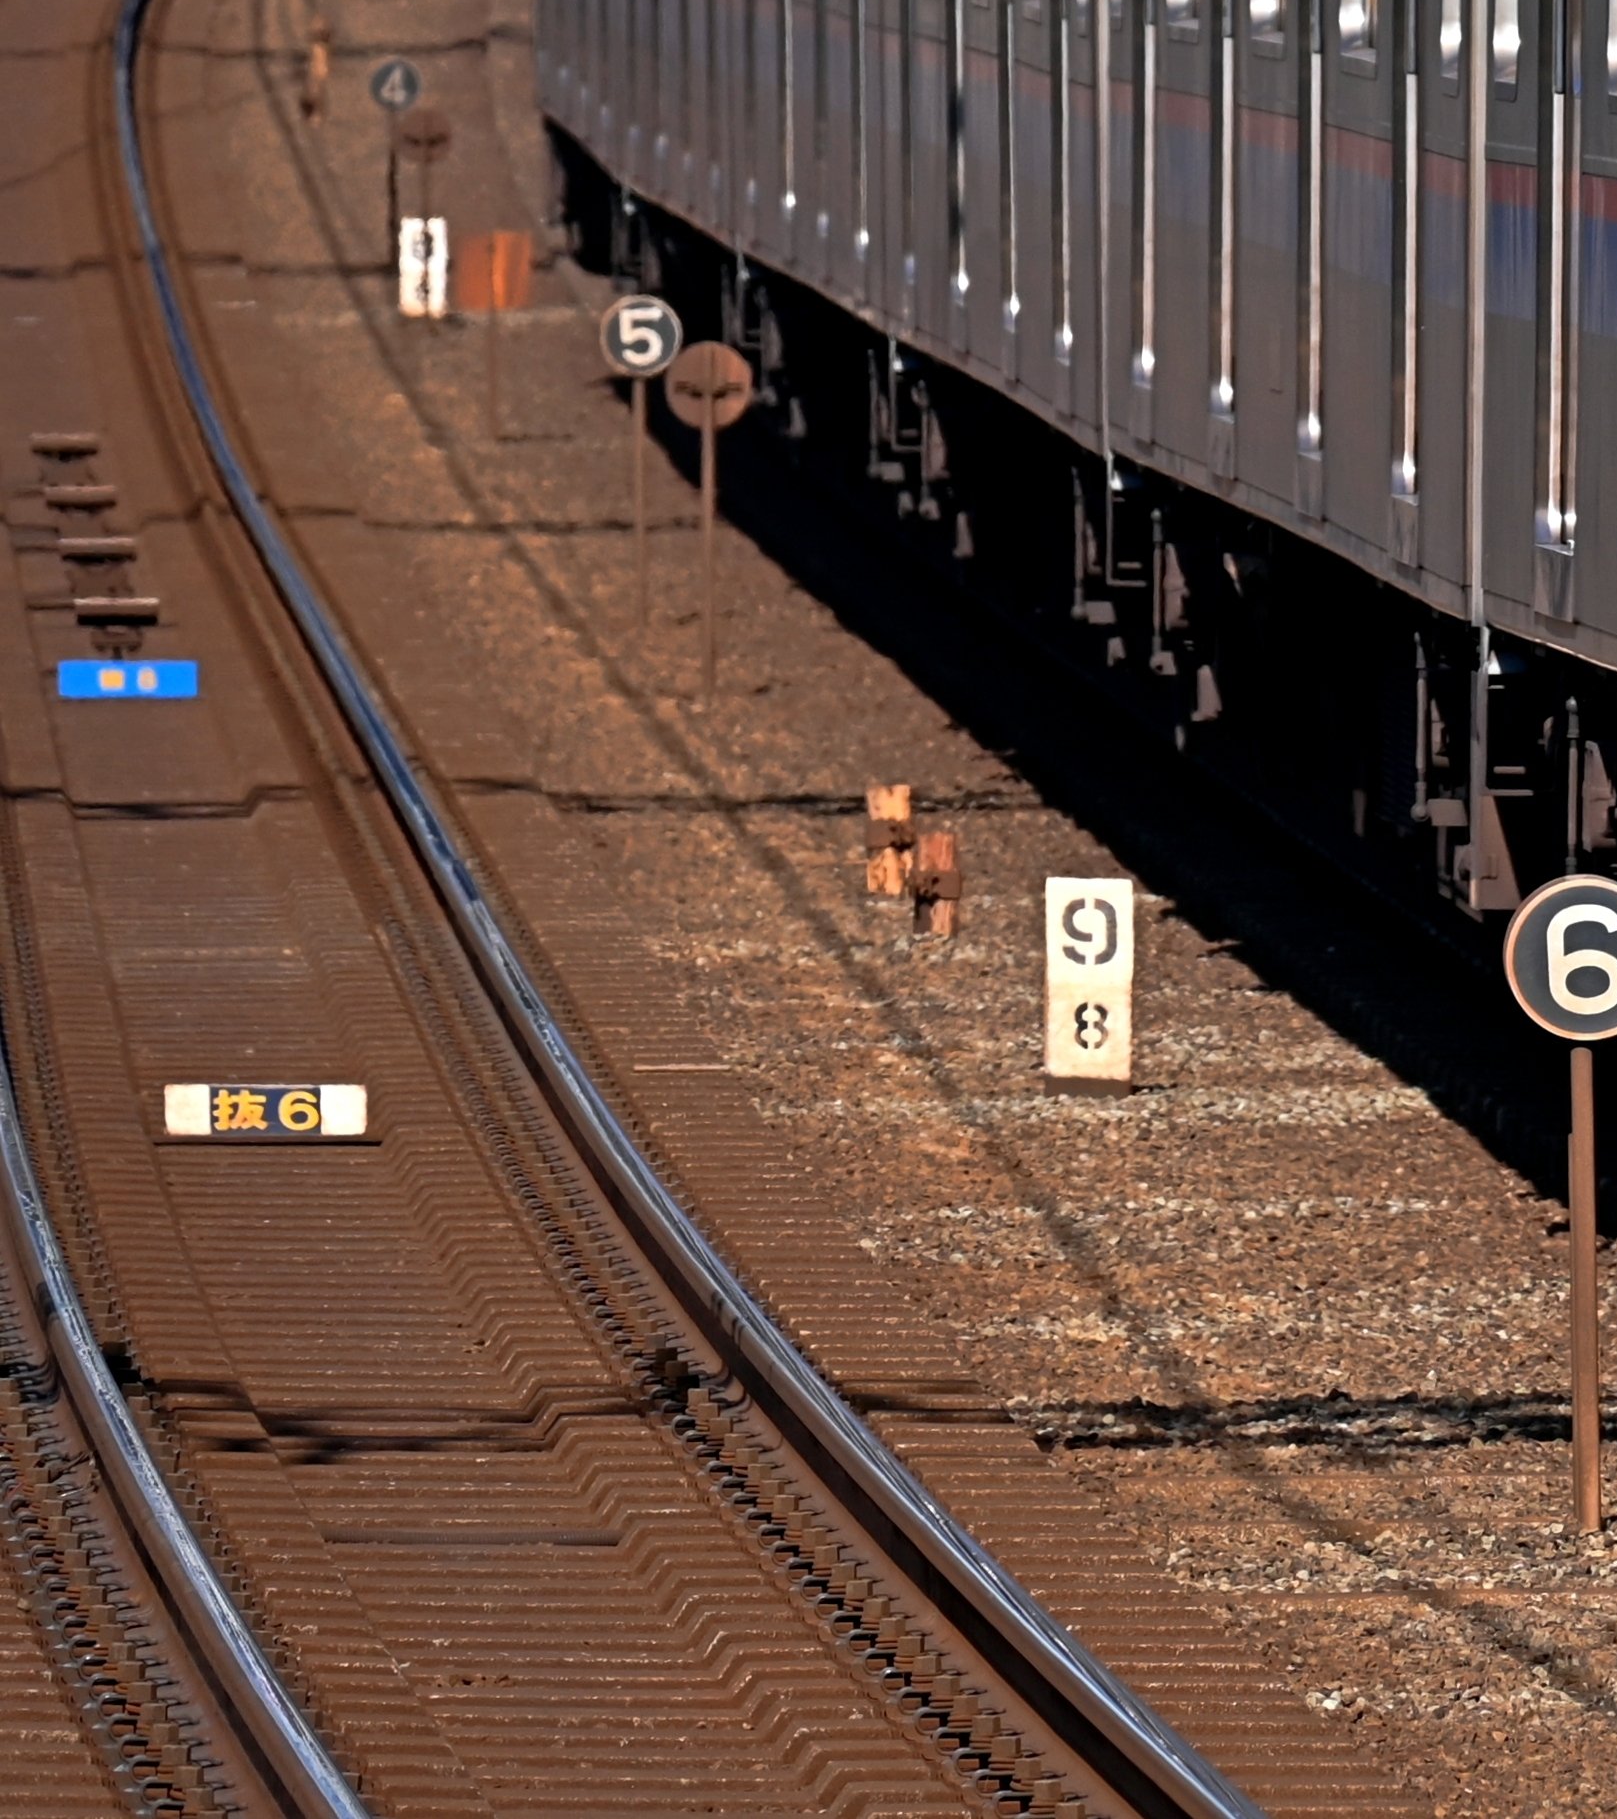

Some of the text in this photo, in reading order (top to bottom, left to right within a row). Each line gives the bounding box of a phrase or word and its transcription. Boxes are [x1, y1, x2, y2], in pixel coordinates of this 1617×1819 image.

[619, 307, 663, 367] 5
[1062, 898, 1117, 965] 9
[1074, 1002, 1109, 1049] 8
